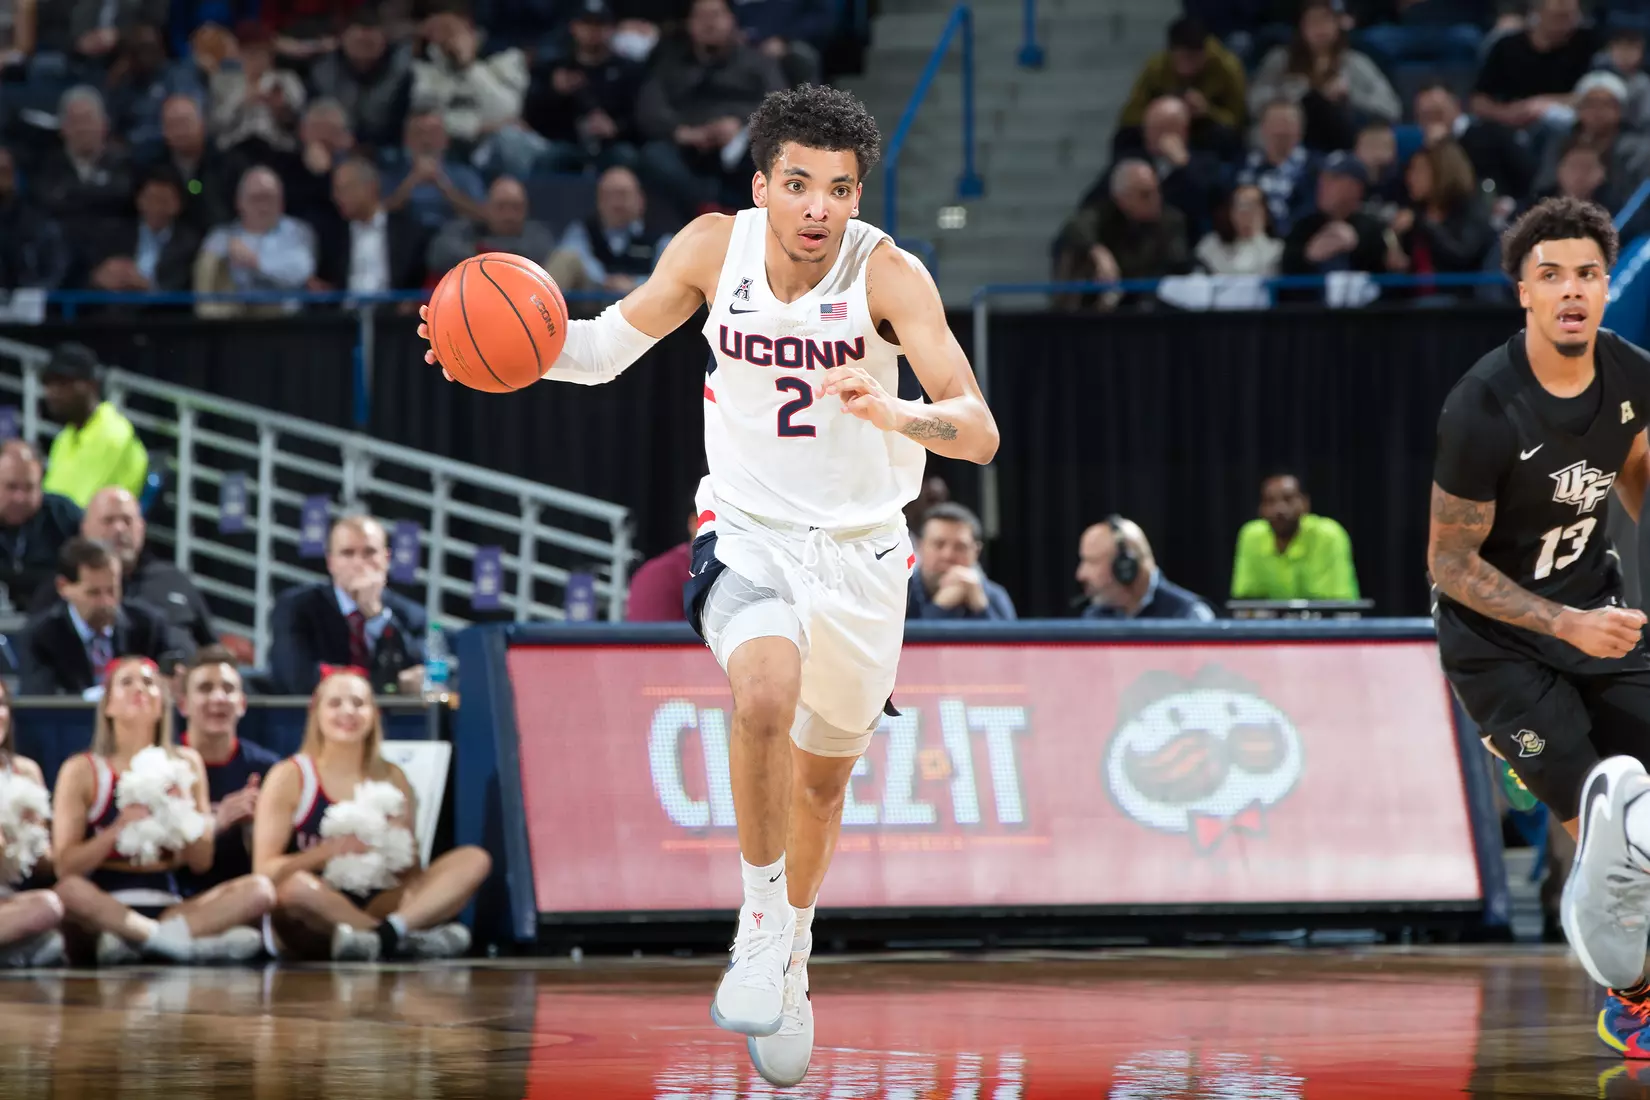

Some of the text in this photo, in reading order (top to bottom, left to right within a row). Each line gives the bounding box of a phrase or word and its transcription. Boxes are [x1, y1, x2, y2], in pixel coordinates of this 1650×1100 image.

[529, 293, 556, 338] UCONN
[719, 323, 866, 371] UCONN
[774, 376, 817, 438] 2
[1549, 459, 1618, 516] UCF
[1534, 516, 1598, 580] 13
